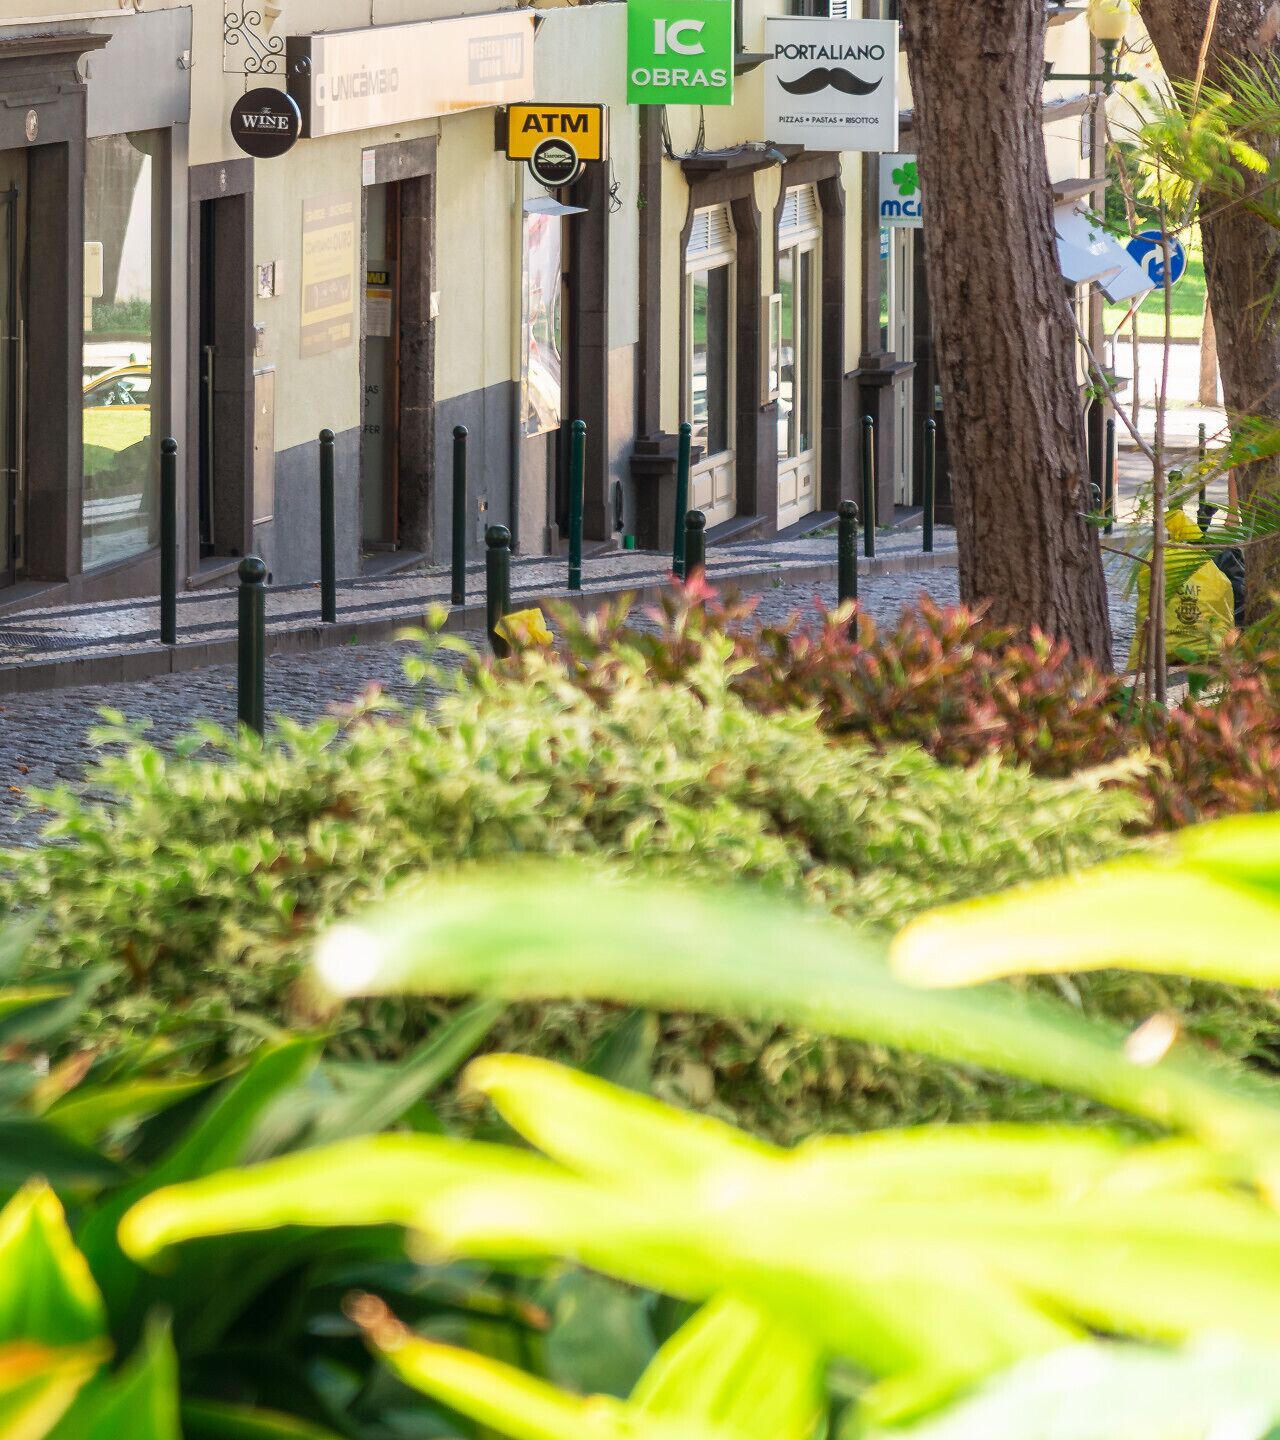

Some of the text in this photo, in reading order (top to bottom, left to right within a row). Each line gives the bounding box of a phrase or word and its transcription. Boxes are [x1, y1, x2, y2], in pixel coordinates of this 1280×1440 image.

[653, 18, 706, 56] IC
[775, 43, 885, 61] PORTALIANO
[631, 68, 727, 88] OBRAS
[241, 114, 289, 130] WINE
[521, 113, 589, 133] ATM
[778, 116, 880, 124] PIZZAS PASTAS RISOTTOS
